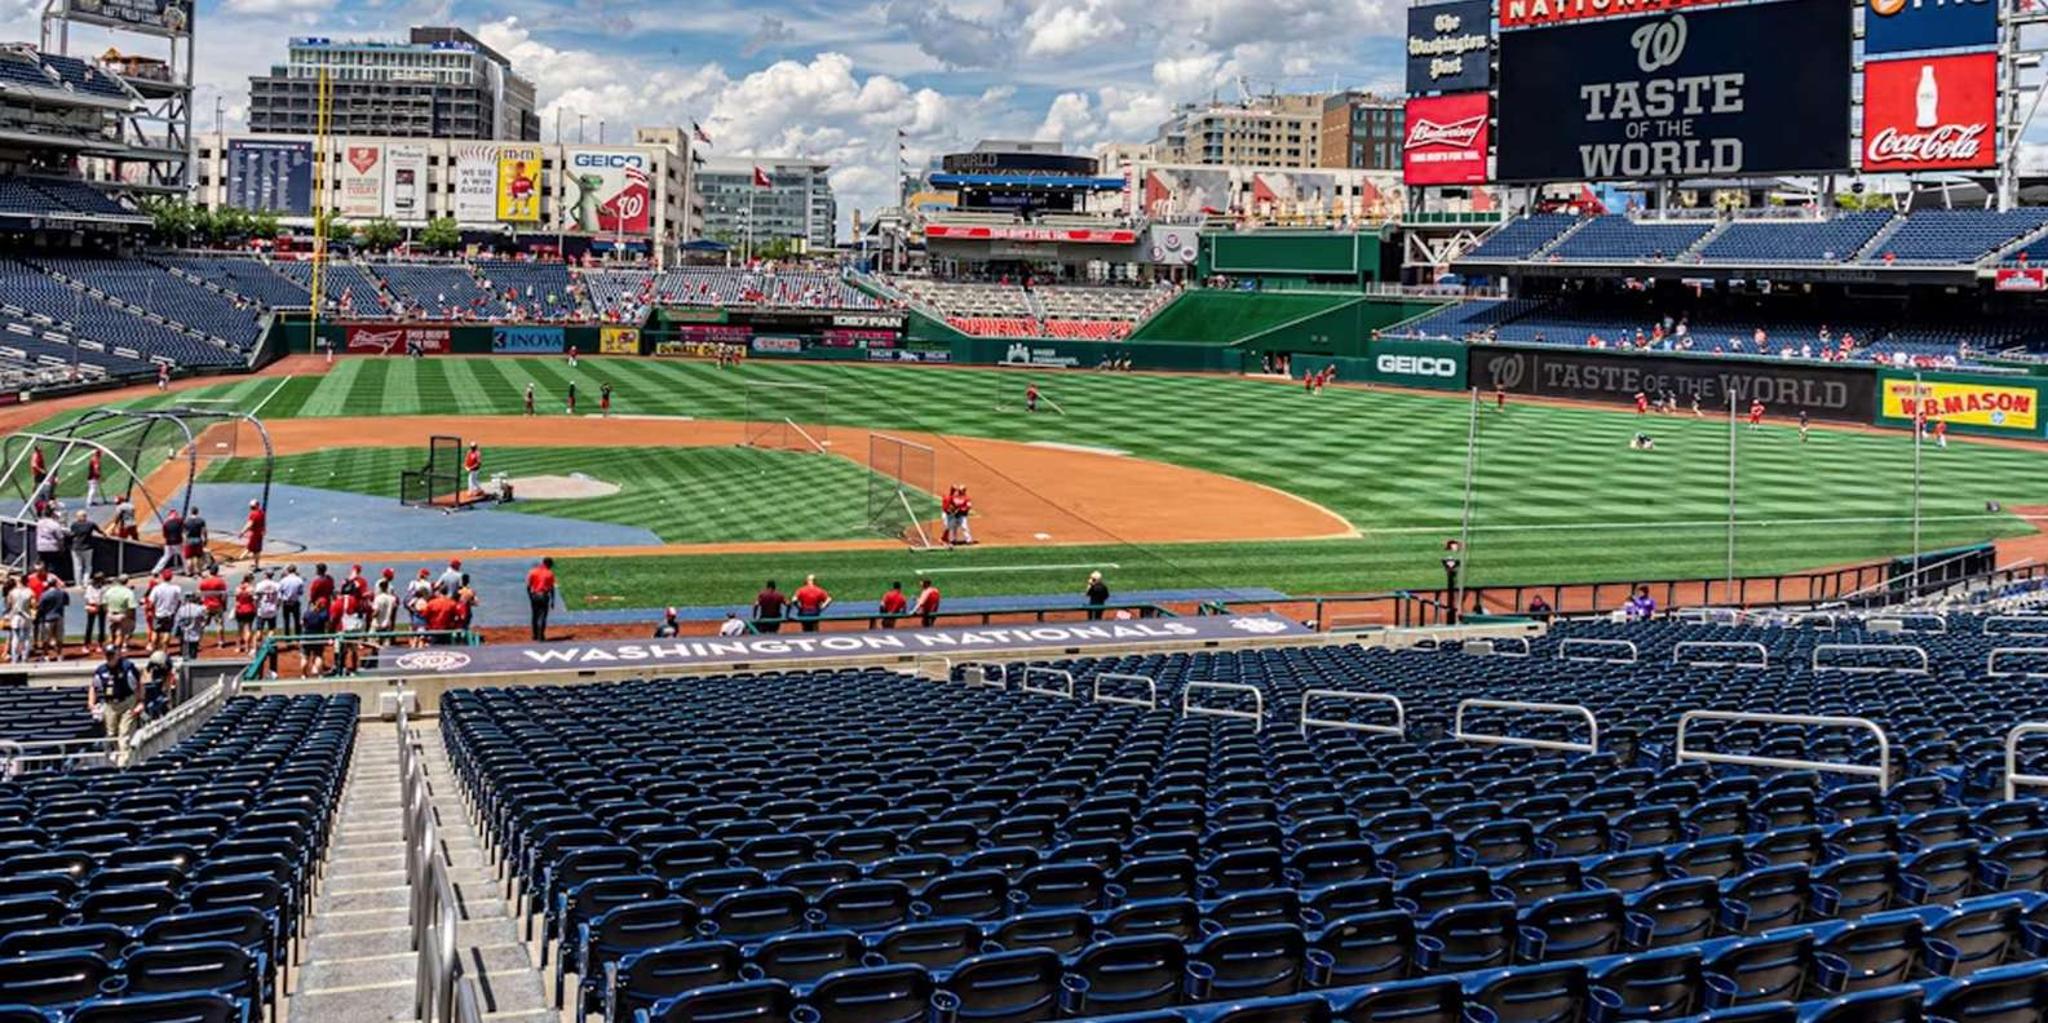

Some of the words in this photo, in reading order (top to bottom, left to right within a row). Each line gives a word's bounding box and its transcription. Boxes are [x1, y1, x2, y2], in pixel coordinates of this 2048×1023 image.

[1509, 0, 1664, 19] NATIO
[1409, 34, 1487, 55] Washington
[1430, 57, 1462, 80] Post
[1581, 73, 1744, 121] TASTE
[1411, 125, 1477, 142] Budweiser
[1625, 122, 1649, 139] OF
[1656, 119, 1694, 137] THE
[1868, 124, 1987, 161] Coca-Cola
[575, 154, 643, 168] GEICO
[1579, 138, 1743, 177] WORLD
[869, 317, 902, 328] FAN
[511, 333, 562, 346] INOVA
[1377, 354, 1456, 376] GEICO
[1543, 363, 1642, 392] TASTE
[1643, 374, 1669, 393] OF
[1673, 376, 1716, 397] THE
[1719, 374, 1848, 408] WORLD
[523, 632, 907, 663] WASHINGTON
[913, 622, 1199, 647] NATIONALS
